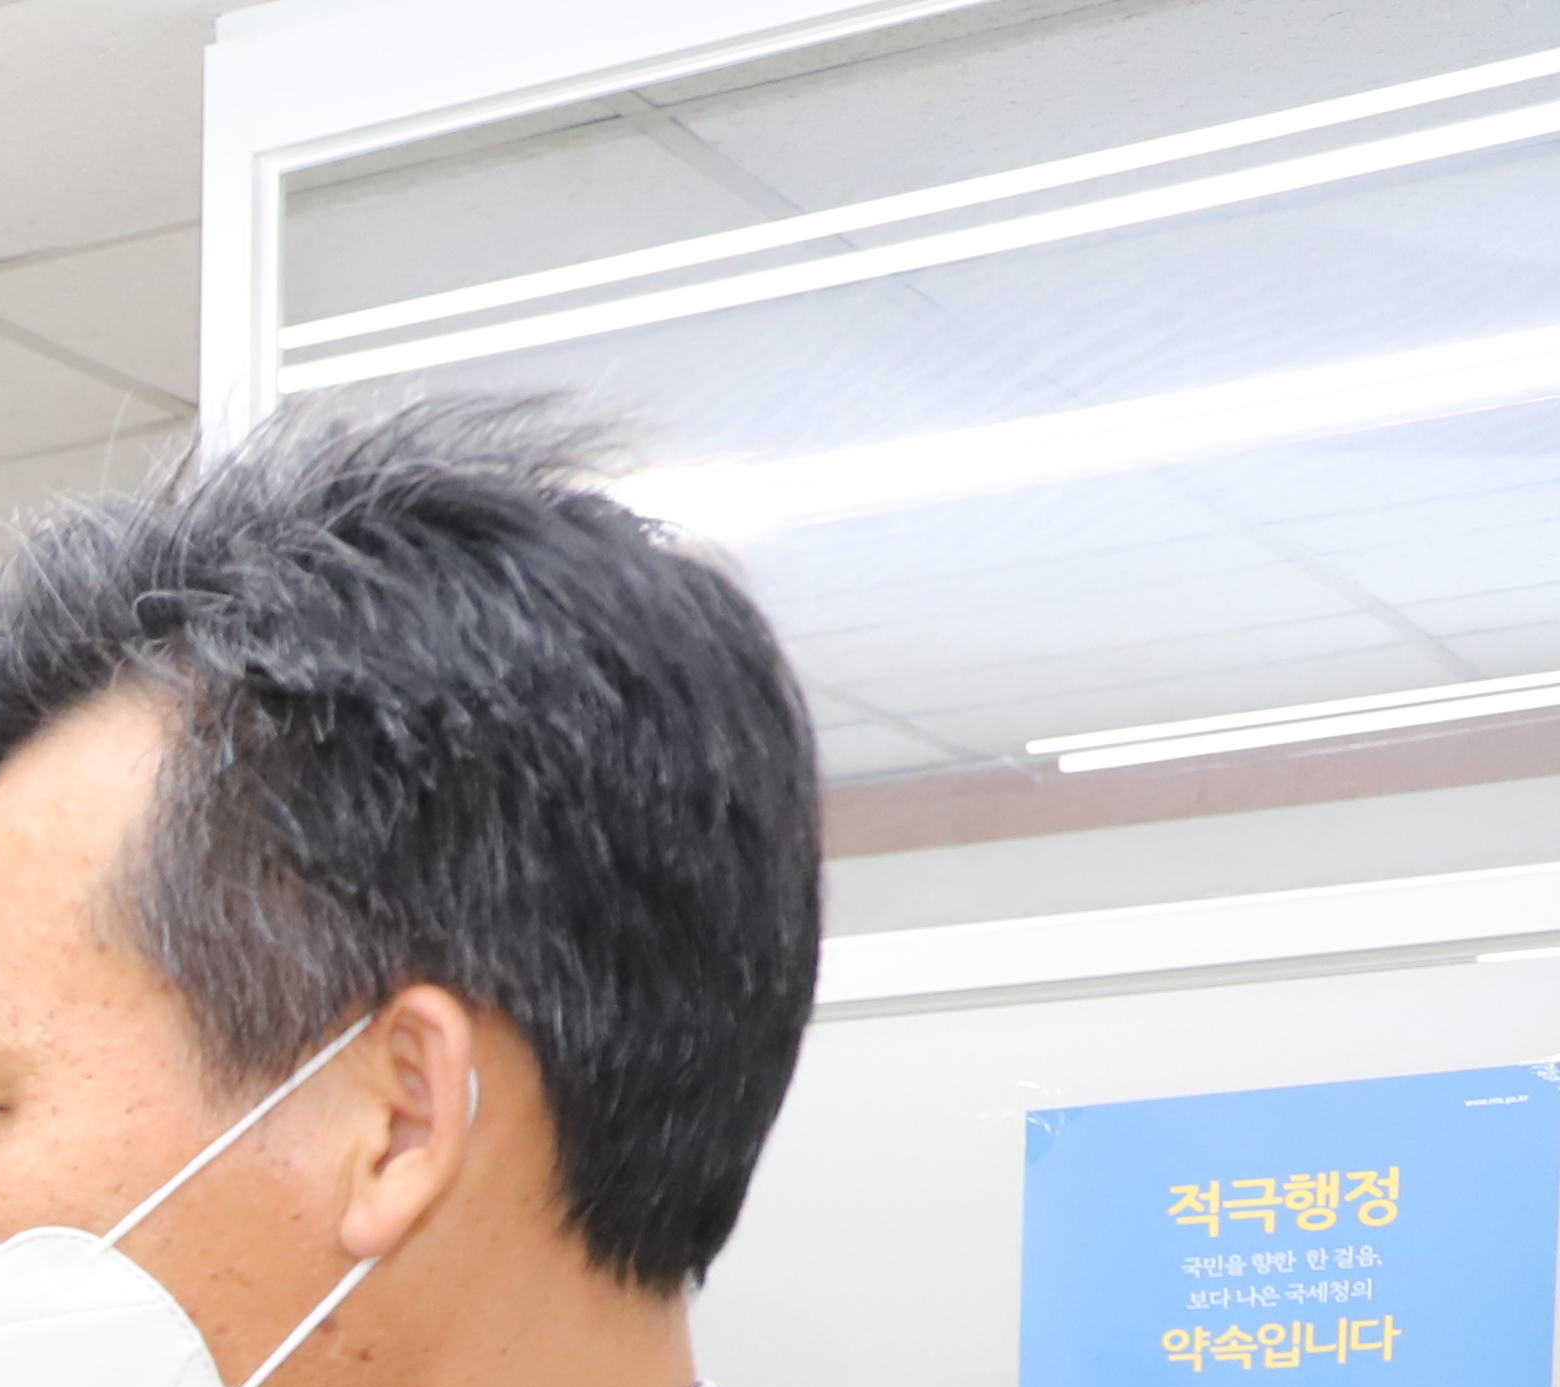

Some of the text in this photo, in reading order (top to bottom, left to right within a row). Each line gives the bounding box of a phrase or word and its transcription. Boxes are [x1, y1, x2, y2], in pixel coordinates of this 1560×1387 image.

[1168, 1165, 1401, 1238] 적극행정
[1181, 1254, 1247, 1278] 국민을
[1251, 1250, 1296, 1275] 향한
[1306, 1247, 1329, 1272] 한
[1186, 1278, 1373, 1310] 보다 나은 국세청의
[1161, 1315, 1403, 1373] 약속입니다
